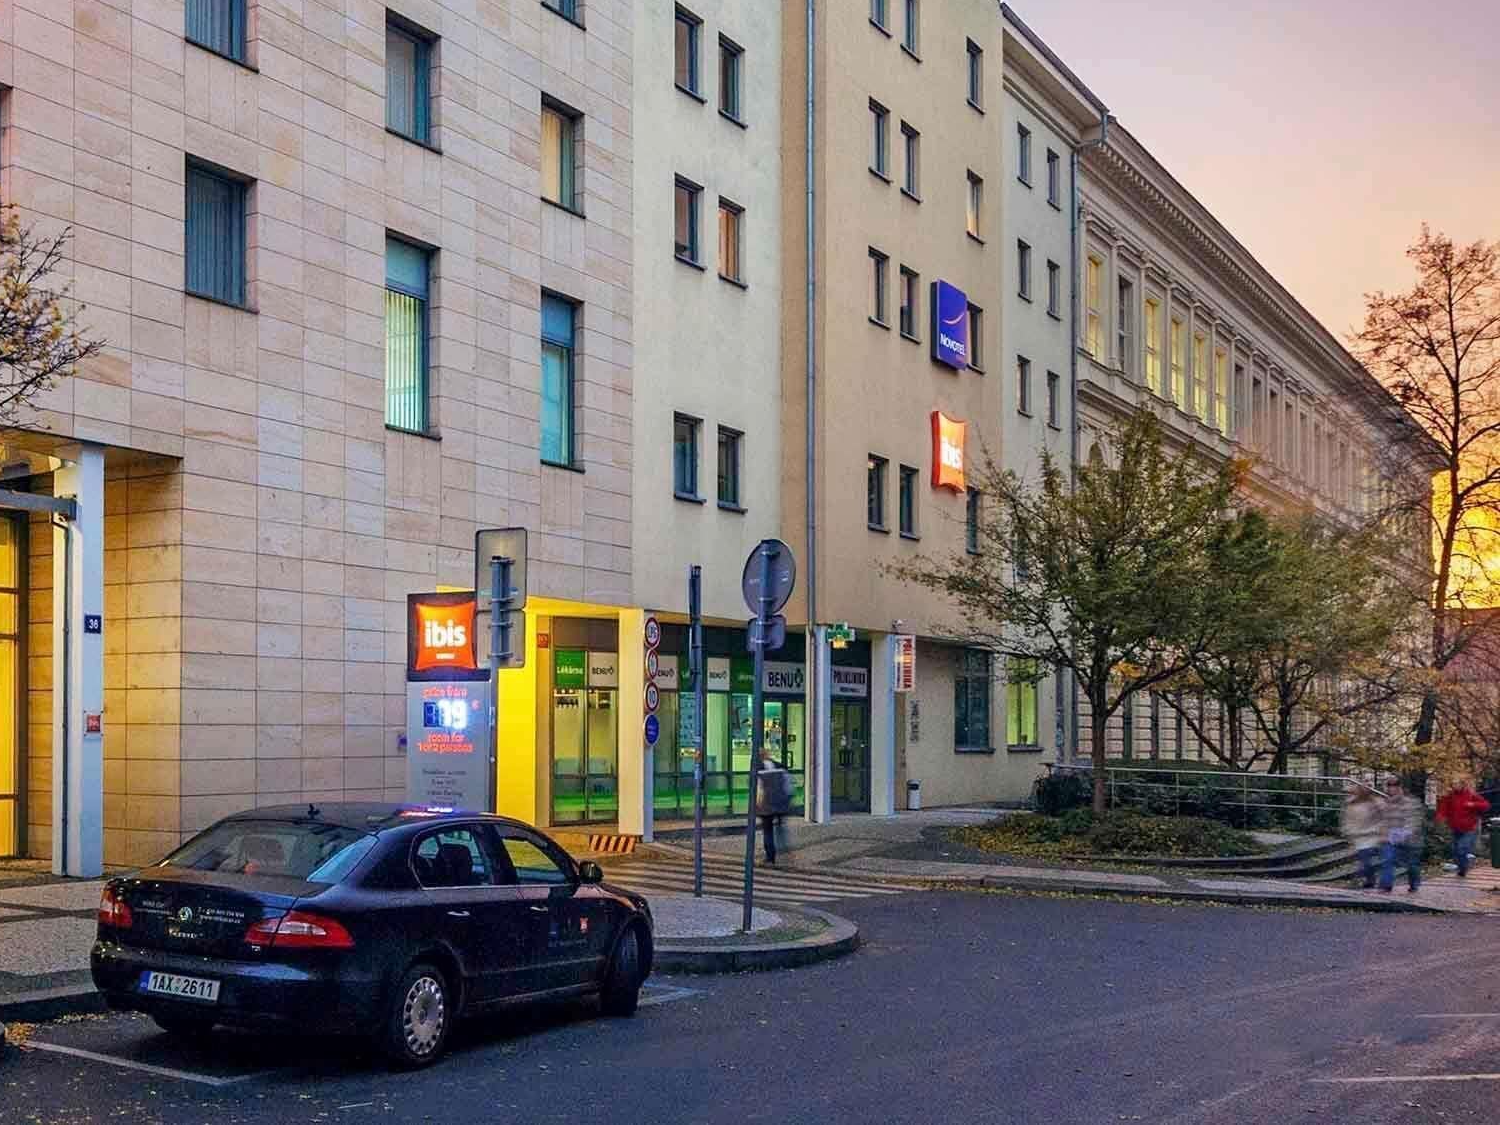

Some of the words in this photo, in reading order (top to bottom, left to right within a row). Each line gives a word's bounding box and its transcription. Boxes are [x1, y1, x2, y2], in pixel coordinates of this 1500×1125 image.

[939, 333, 966, 357] NOVOTEL
[424, 618, 467, 648] ibis
[768, 671, 793, 688] BENU
[152, 974, 173, 991] 1AX
[181, 978, 213, 997] 2611
